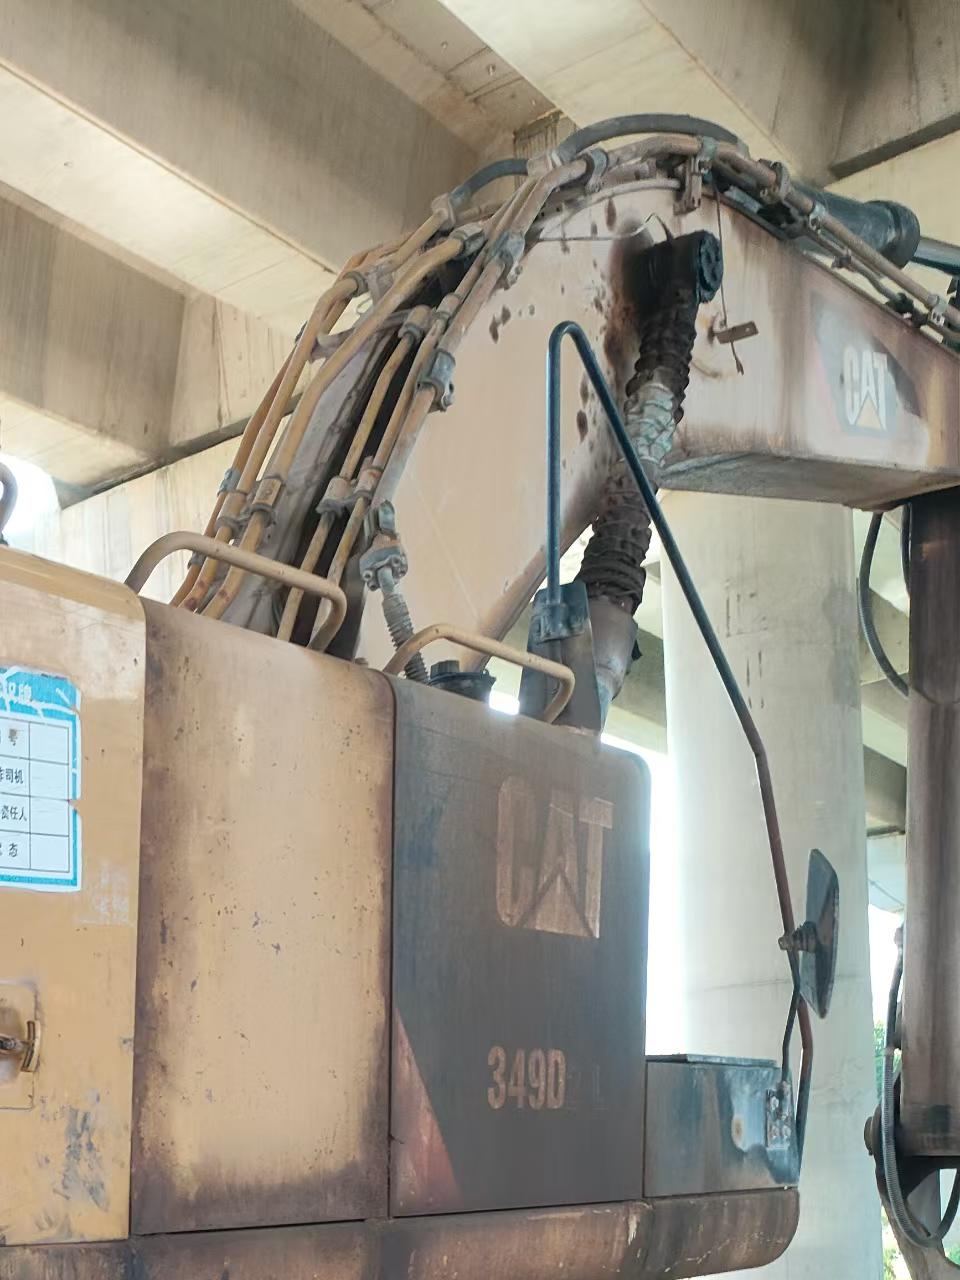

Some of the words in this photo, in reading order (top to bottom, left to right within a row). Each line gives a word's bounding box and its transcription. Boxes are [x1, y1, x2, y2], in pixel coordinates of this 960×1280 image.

[844, 346, 888, 431] CAT
[496, 775, 613, 939] CAT
[487, 1045, 566, 1110] 349D
